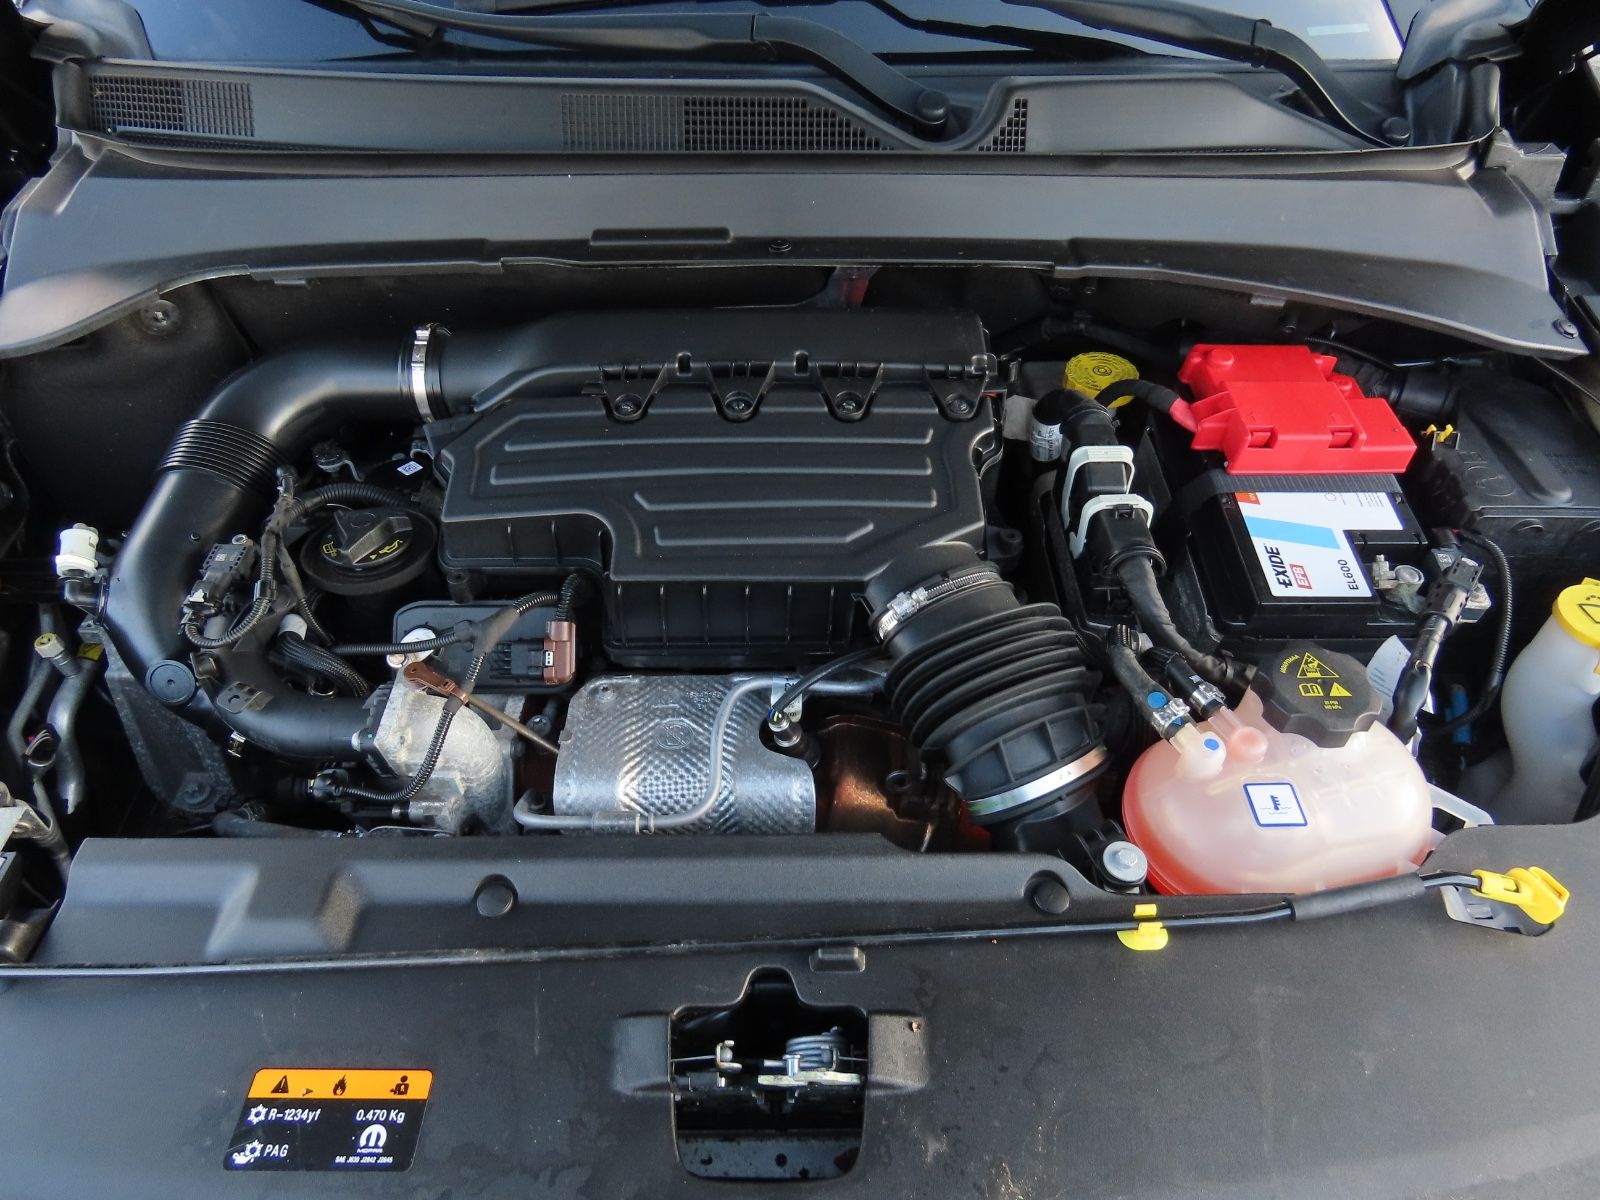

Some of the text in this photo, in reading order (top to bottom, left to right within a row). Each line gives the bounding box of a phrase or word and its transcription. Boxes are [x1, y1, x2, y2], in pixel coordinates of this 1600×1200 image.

[1265, 545, 1293, 589] EXIDE
[1337, 559, 1359, 591] EL600
[268, 1109, 321, 1123] R-1234yf
[355, 1108, 406, 1124] 0.470 Kg
[264, 1144, 288, 1157] PAG
